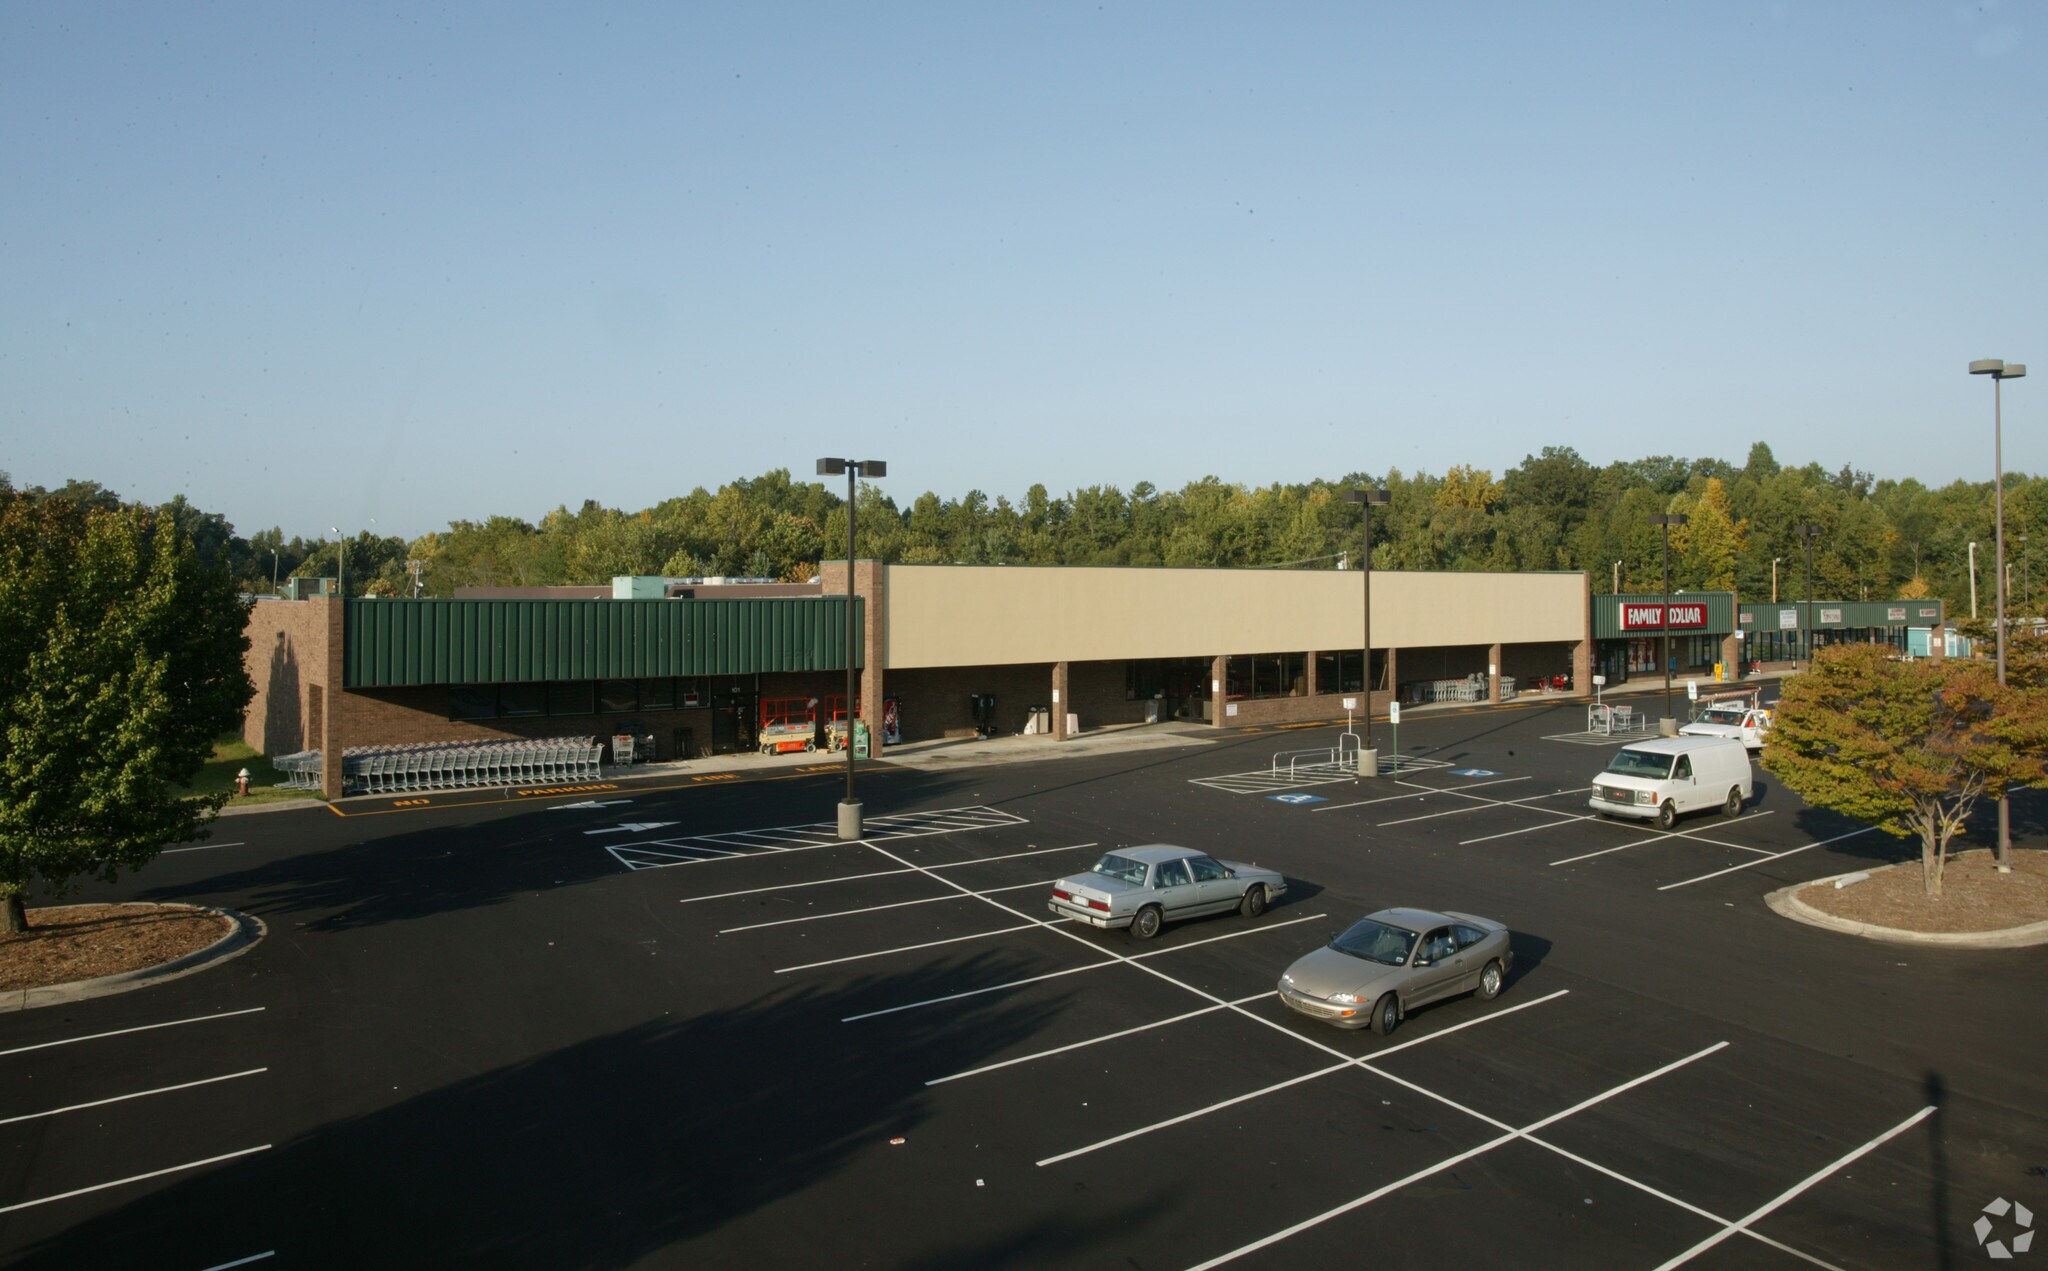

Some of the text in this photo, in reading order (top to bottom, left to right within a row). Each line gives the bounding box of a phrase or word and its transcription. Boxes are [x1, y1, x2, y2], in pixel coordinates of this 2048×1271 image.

[1628, 607, 1701, 625] FAMILY DOLLAR
[691, 773, 740, 782] FIRE
[392, 783, 619, 807] NO PARKING
